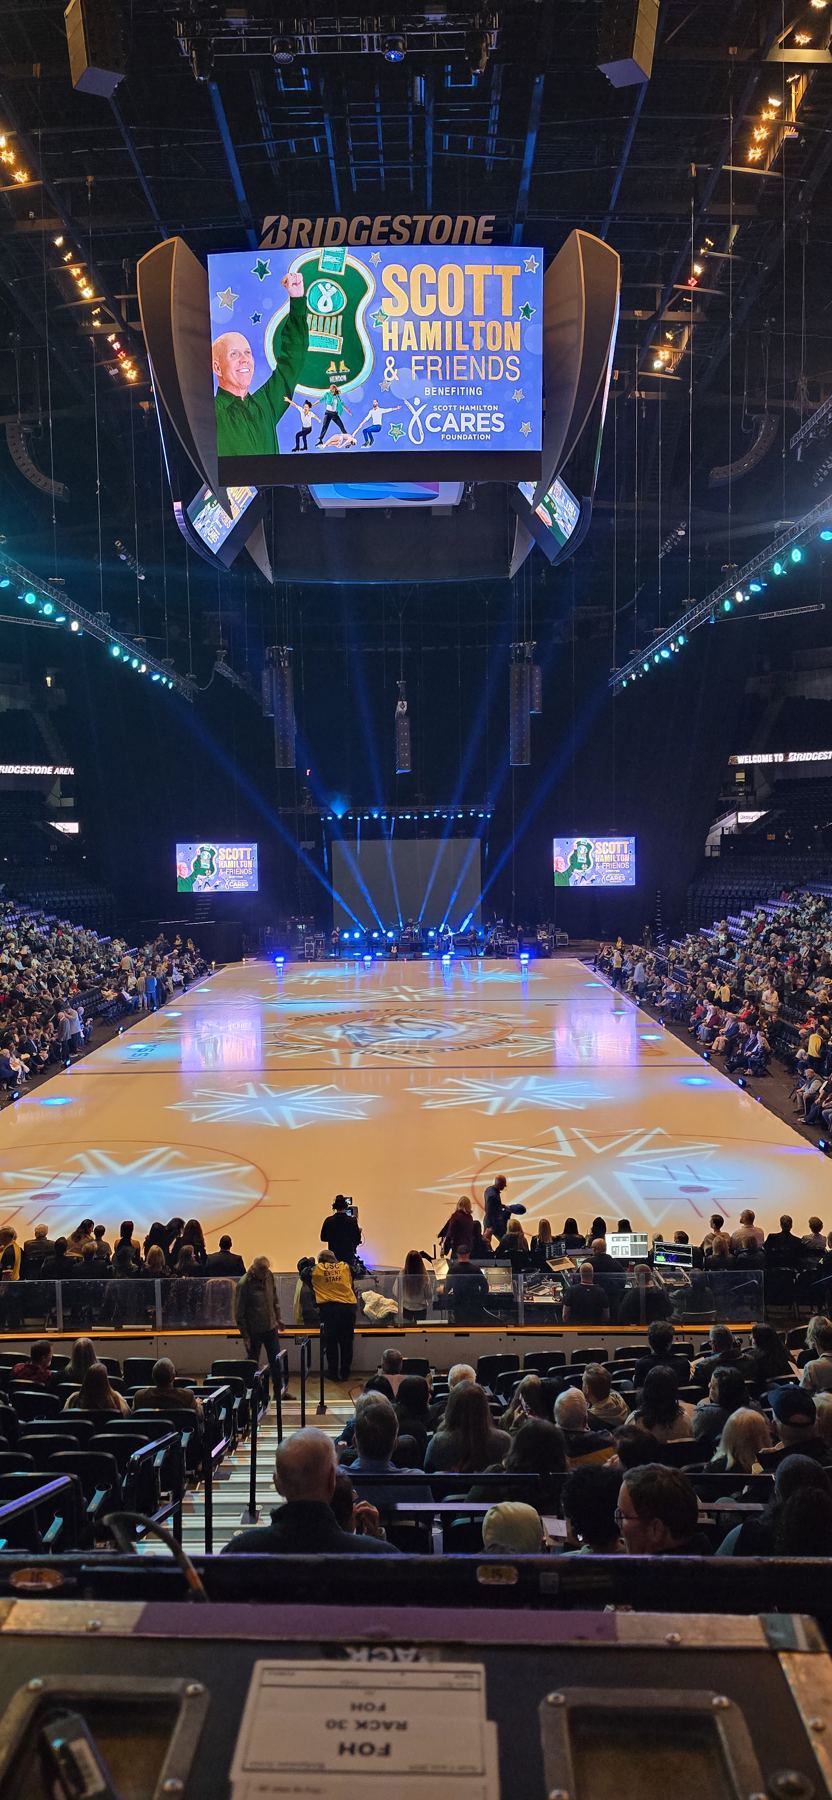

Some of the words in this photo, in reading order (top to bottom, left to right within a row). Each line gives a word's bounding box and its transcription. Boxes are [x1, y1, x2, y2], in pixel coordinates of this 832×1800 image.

[258, 215, 497, 249] BRIDGESTONE
[381, 263, 521, 317] SCOTT
[381, 321, 521, 352] HAMILTON
[384, 356, 399, 382] &
[411, 355, 521, 382] FRIENDS
[424, 386, 483, 397] BENEFITING
[425, 412, 505, 433] CARES
[440, 433, 491, 441] FOUNDATION
[737, 754, 773, 764] WELCOME
[774, 753, 784, 762] TO
[54, 767, 75, 775] AREN
[219, 848, 252, 860] SCOTT
[595, 841, 629, 854] SCOTT
[350, 1701, 387, 1713] FOH
[325, 1719, 347, 1731] 30
[353, 1719, 408, 1732] RACK
[337, 1741, 392, 1758] FOH
